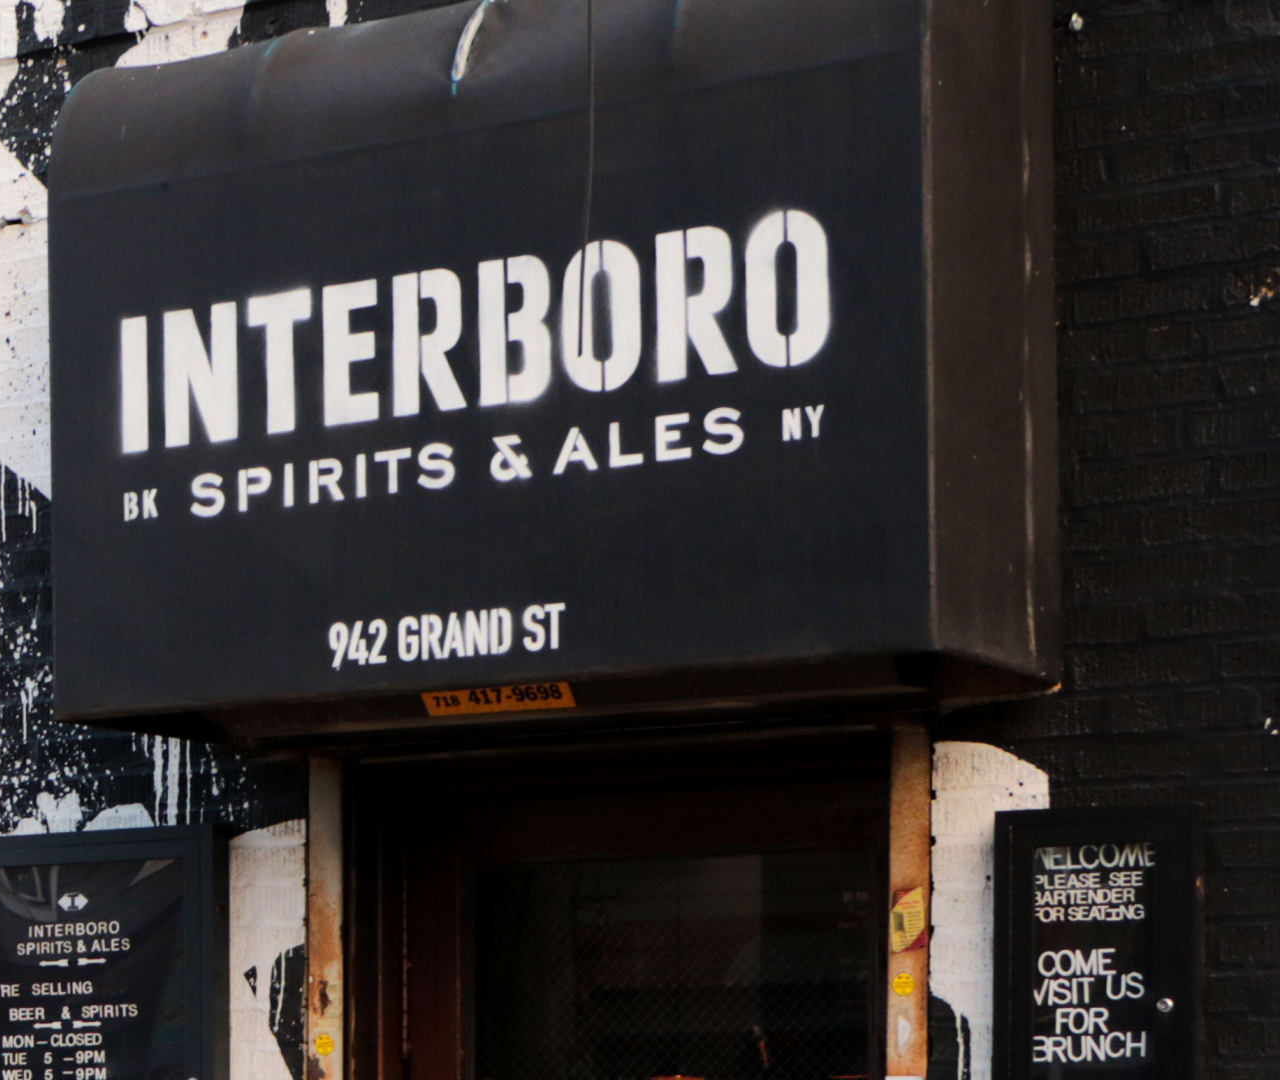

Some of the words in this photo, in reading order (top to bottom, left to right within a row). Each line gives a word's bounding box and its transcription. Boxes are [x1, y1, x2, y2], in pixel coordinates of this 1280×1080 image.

[121, 209, 831, 455] INTERBORO
[123, 488, 159, 522] BK
[190, 442, 456, 519] SPIRITS
[489, 434, 533, 482] &
[552, 406, 746, 475] ALES
[781, 404, 825, 442] NY
[328, 618, 388, 670] 942
[397, 607, 513, 662] GRAND
[522, 602, 566, 652] ST
[432, 695, 461, 709] 718
[468, 683, 564, 706] 417-9698
[1108, 871, 1143, 887] SEE
[1068, 904, 1145, 922] SEATING
[28, 921, 121, 938] INTERBORO
[17, 940, 73, 956] SPIRITS
[77, 939, 87, 954] &
[91, 938, 131, 953] ALES
[1038, 948, 1117, 977] COME
[31, 981, 93, 996] SELLING
[1033, 977, 1095, 1006] VISIT
[1106, 972, 1145, 1000] US
[9, 1006, 45, 1022] BEER
[61, 1006, 71, 1020] &
[81, 1004, 138, 1019] SPIRITS
[1055, 1007, 1109, 1034] FOR
[1, 1052, 28, 1066] TUE
